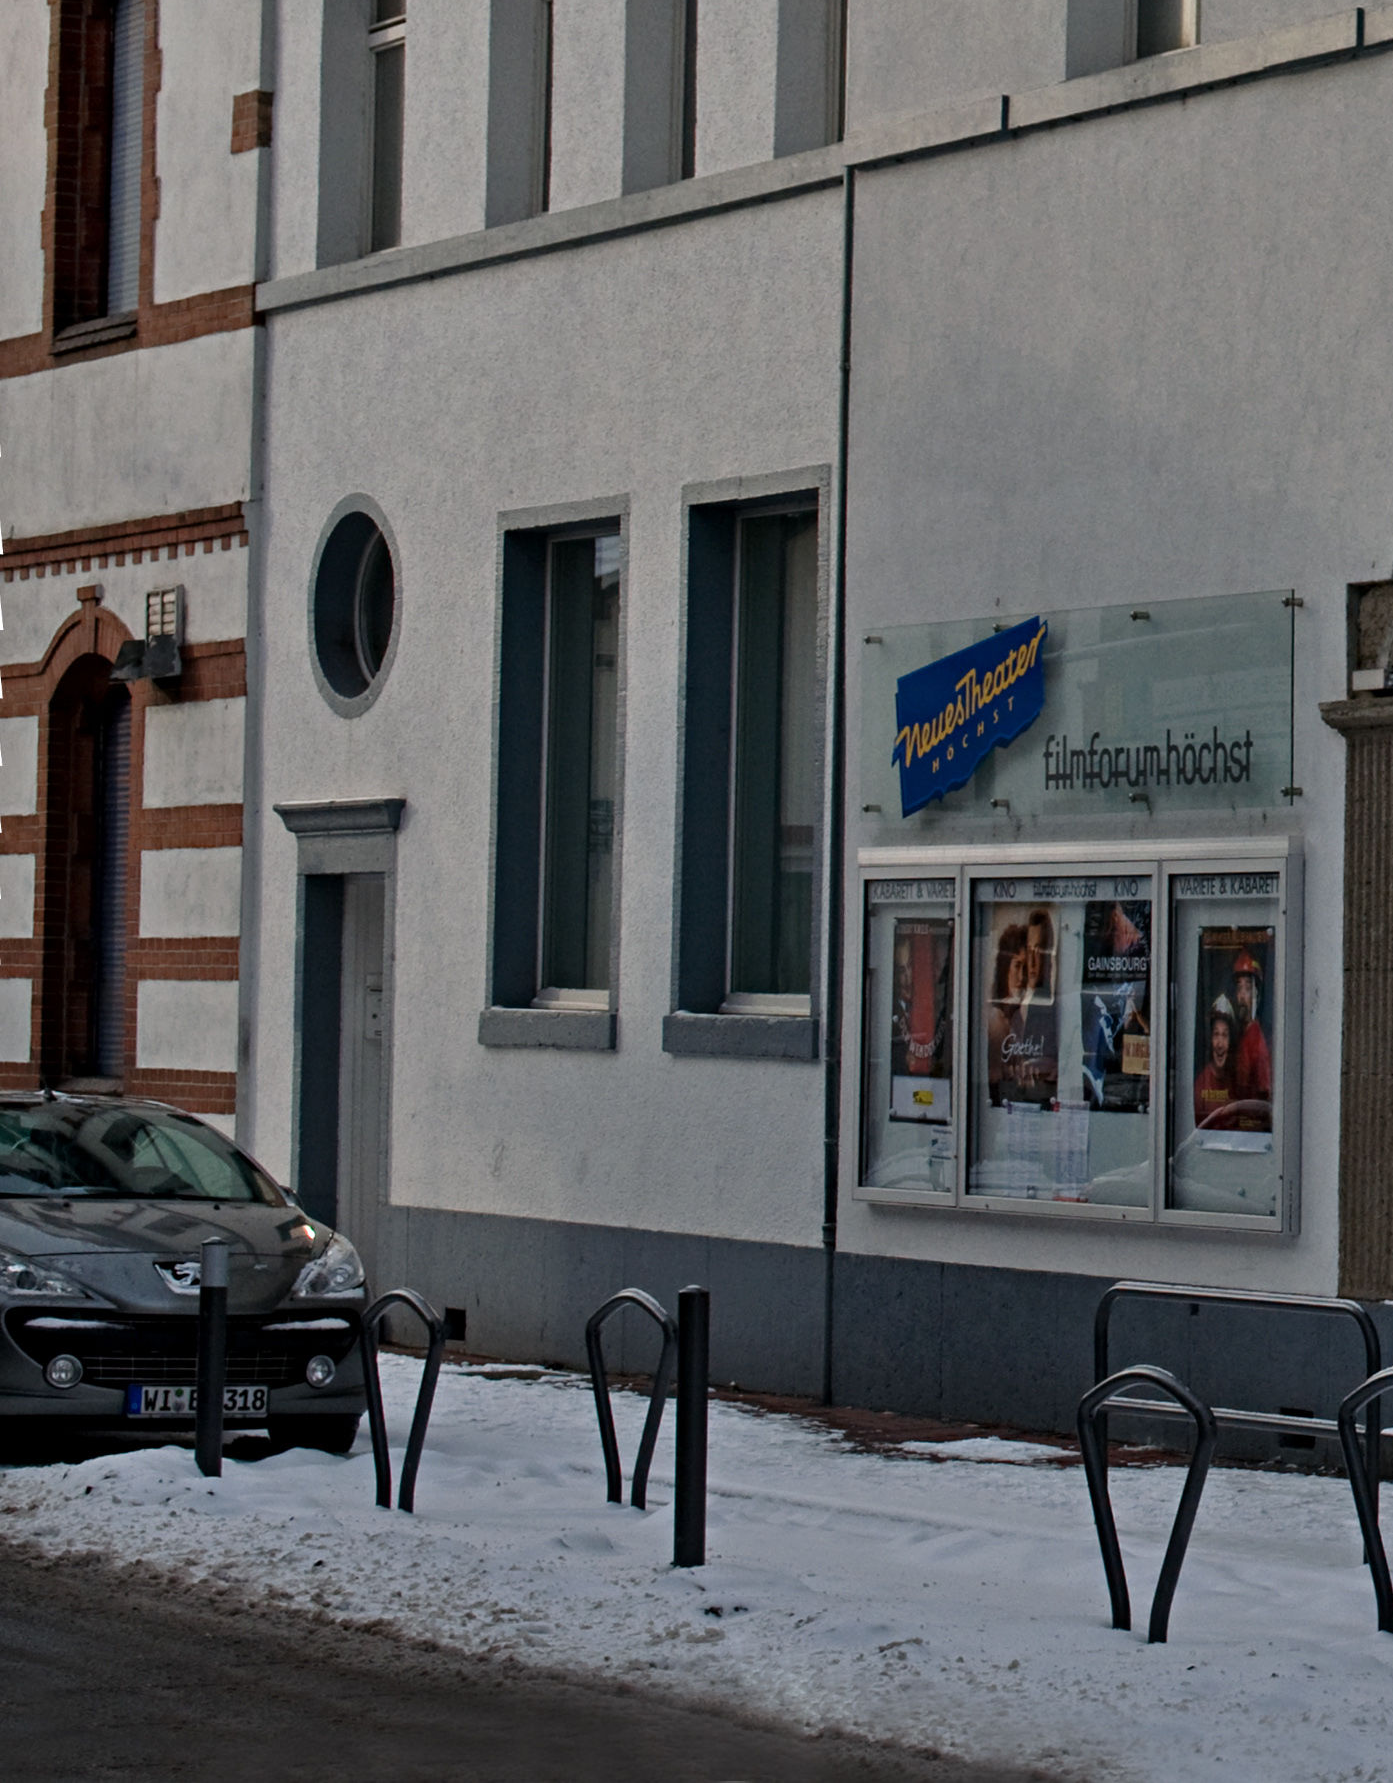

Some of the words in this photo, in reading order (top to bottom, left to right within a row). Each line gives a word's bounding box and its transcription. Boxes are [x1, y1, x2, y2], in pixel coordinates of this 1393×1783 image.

[1043, 725, 1254, 791] filmforumhöchst
[873, 882, 913, 899] KABARETT
[993, 881, 1017, 898] KINO
[1113, 879, 1139, 898] KINO
[1218, 878, 1227, 895] &
[1230, 875, 1279, 895] KABARETT
[1087, 956, 1147, 972] GAINSBOURG
[1000, 1033, 1045, 1063] Goethe!
[144, 1389, 171, 1412] WI
[223, 1389, 266, 1411] 318
